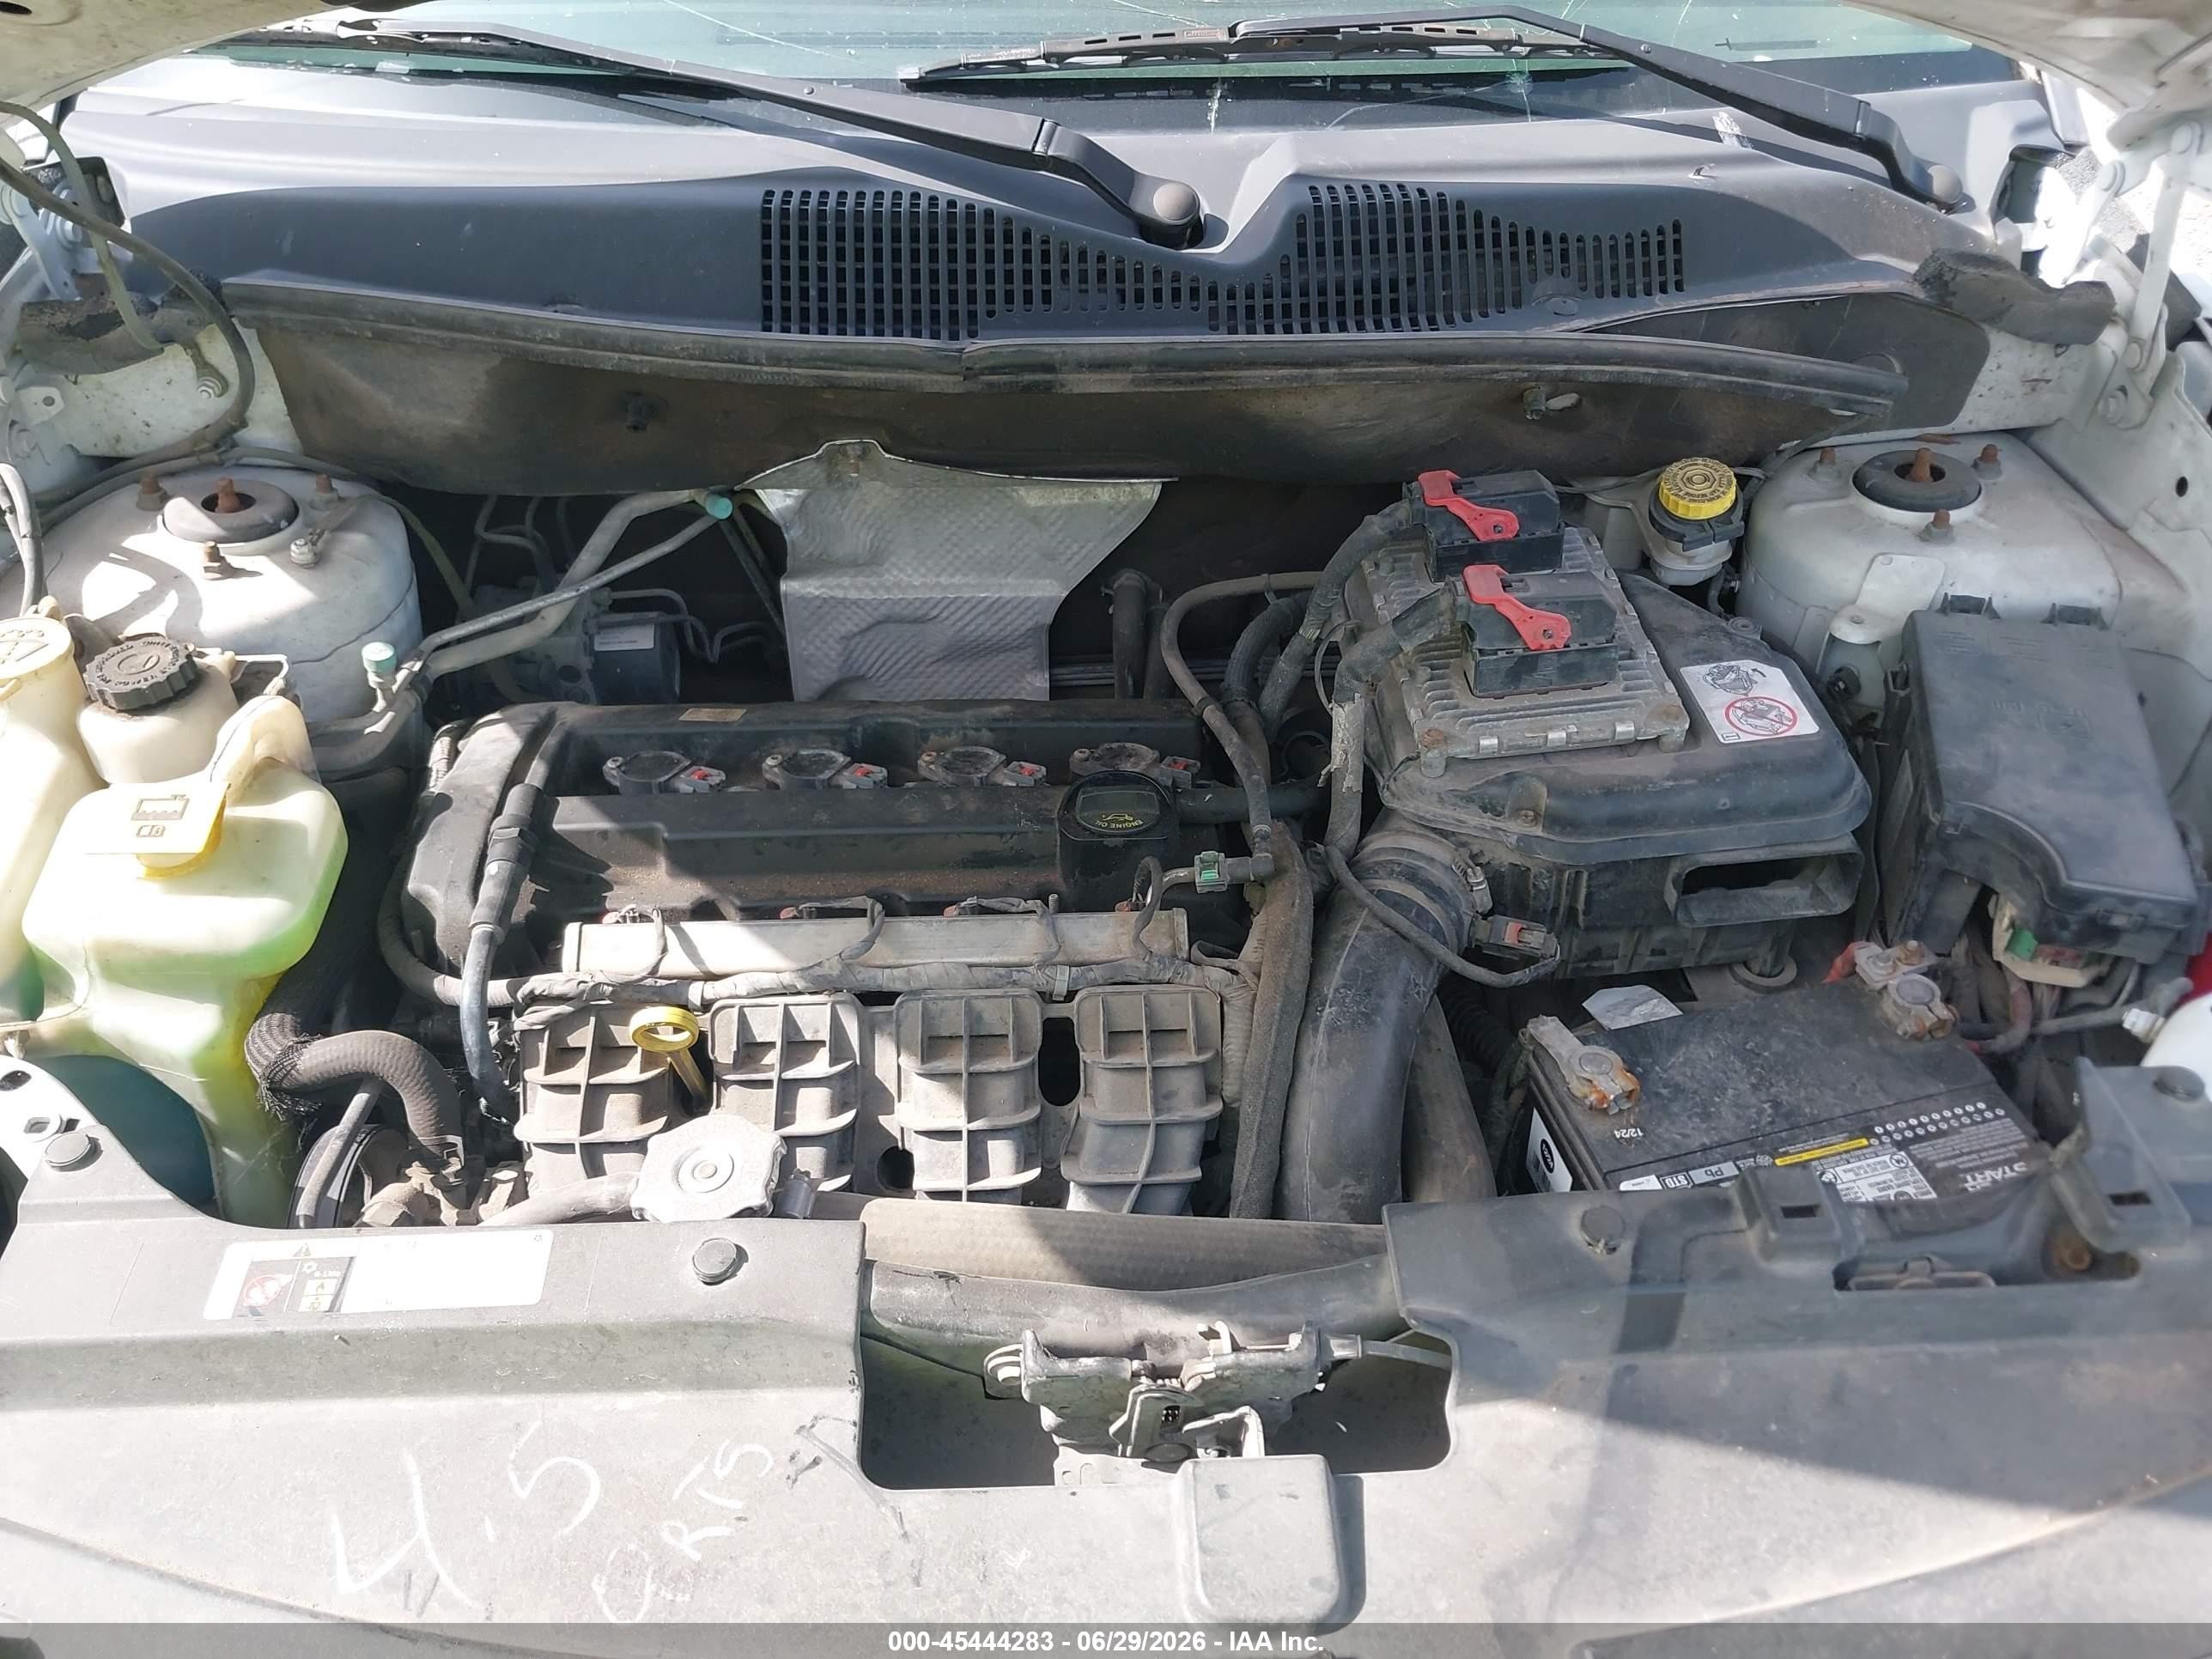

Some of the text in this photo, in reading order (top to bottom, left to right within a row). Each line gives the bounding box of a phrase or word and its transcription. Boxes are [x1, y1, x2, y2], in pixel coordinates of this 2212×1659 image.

[1095, 818, 1144, 829] ENGINE OIL
[1613, 1127, 1644, 1139] 12/24
[1705, 1166, 1725, 1178] Pb
[1664, 1175, 1687, 1188] STD
